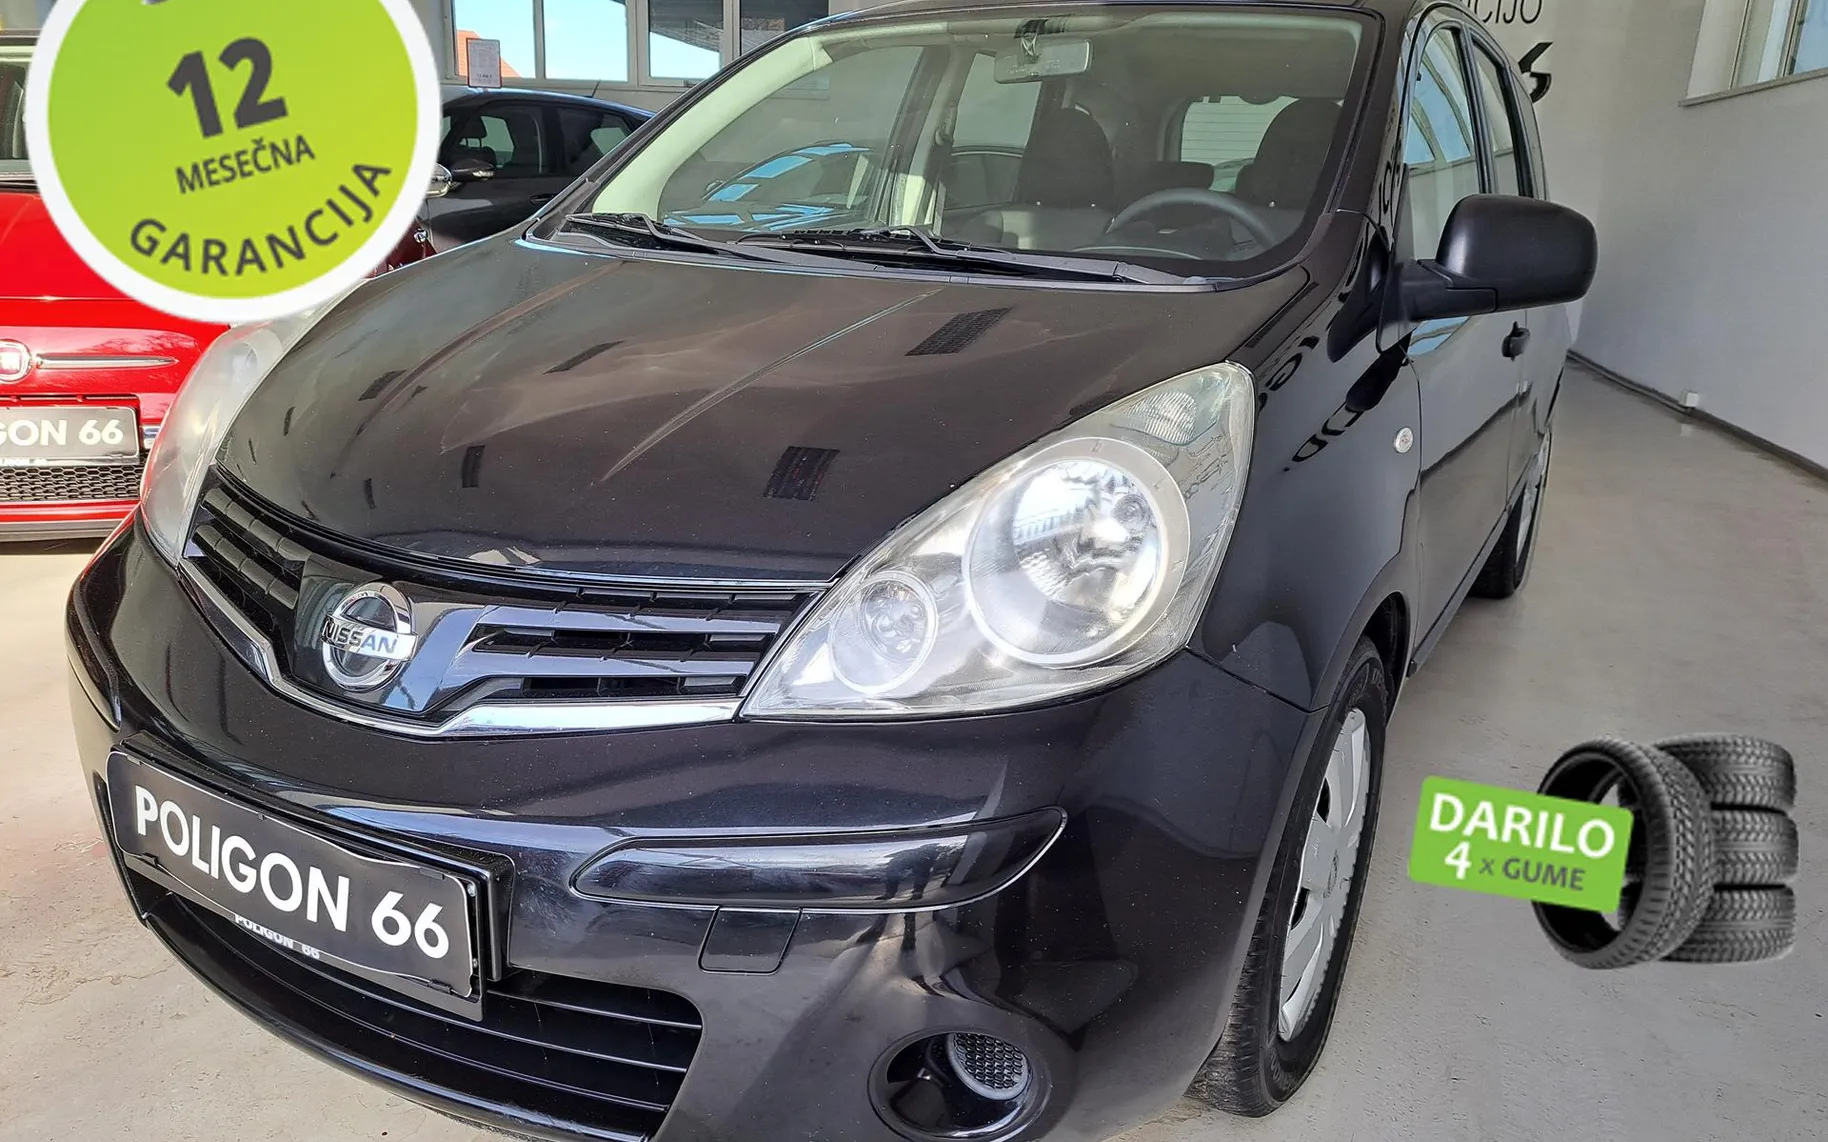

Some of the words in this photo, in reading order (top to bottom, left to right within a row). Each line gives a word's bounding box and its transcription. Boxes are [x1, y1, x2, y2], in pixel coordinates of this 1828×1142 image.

[78, 419, 124, 446] 66
[322, 618, 398, 654] NISSAN
[134, 785, 350, 932] POLIGON
[371, 891, 450, 960] 66
